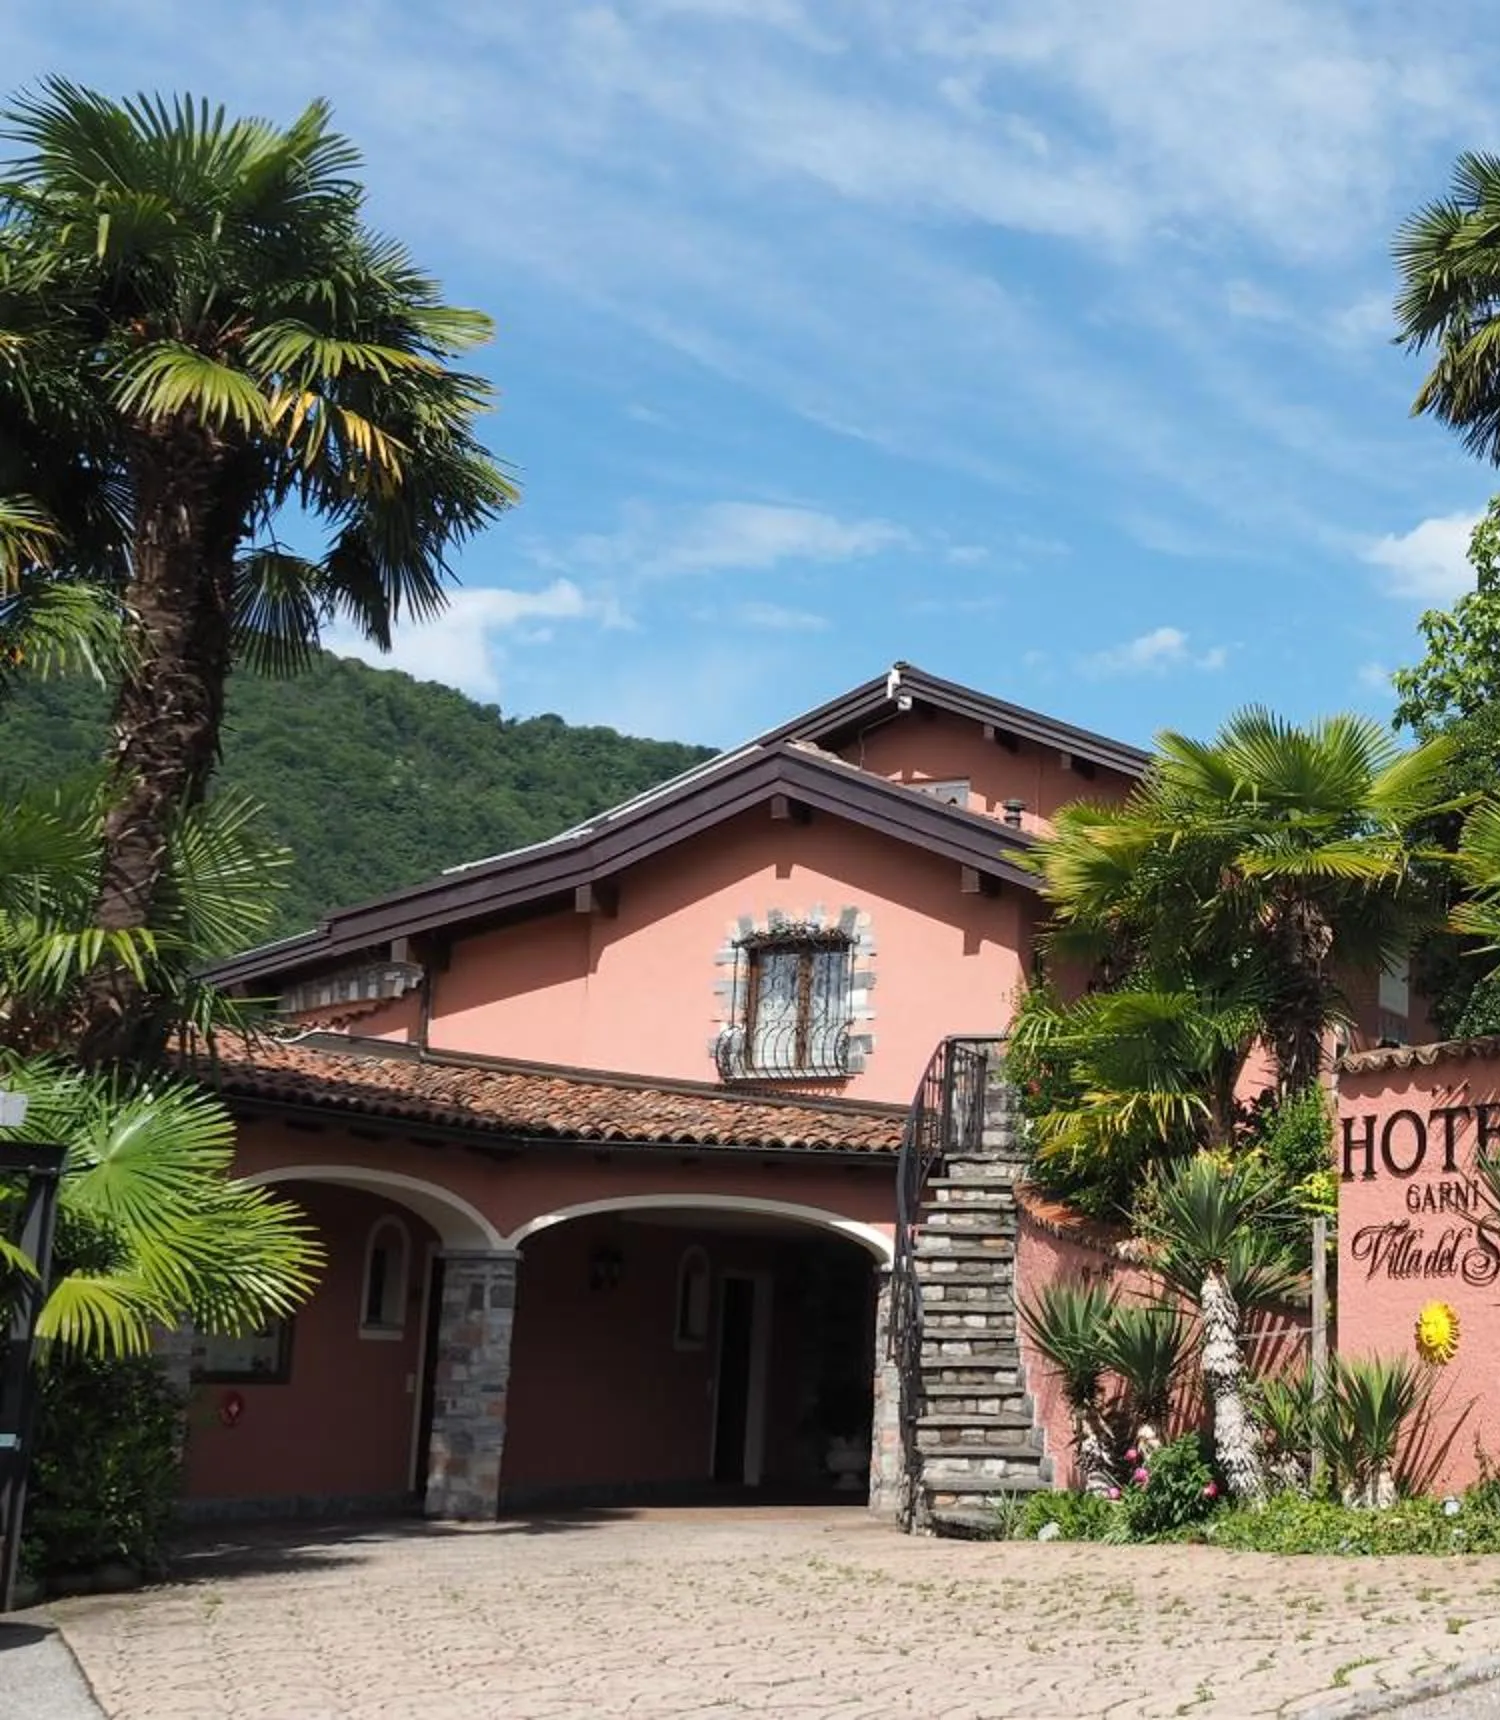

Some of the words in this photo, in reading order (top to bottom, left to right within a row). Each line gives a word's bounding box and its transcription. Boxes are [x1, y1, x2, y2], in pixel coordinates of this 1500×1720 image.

[1406, 1179, 1480, 1213] GARNI
[1351, 1218, 1424, 1281] Villa
[1423, 1226, 1473, 1279] del
